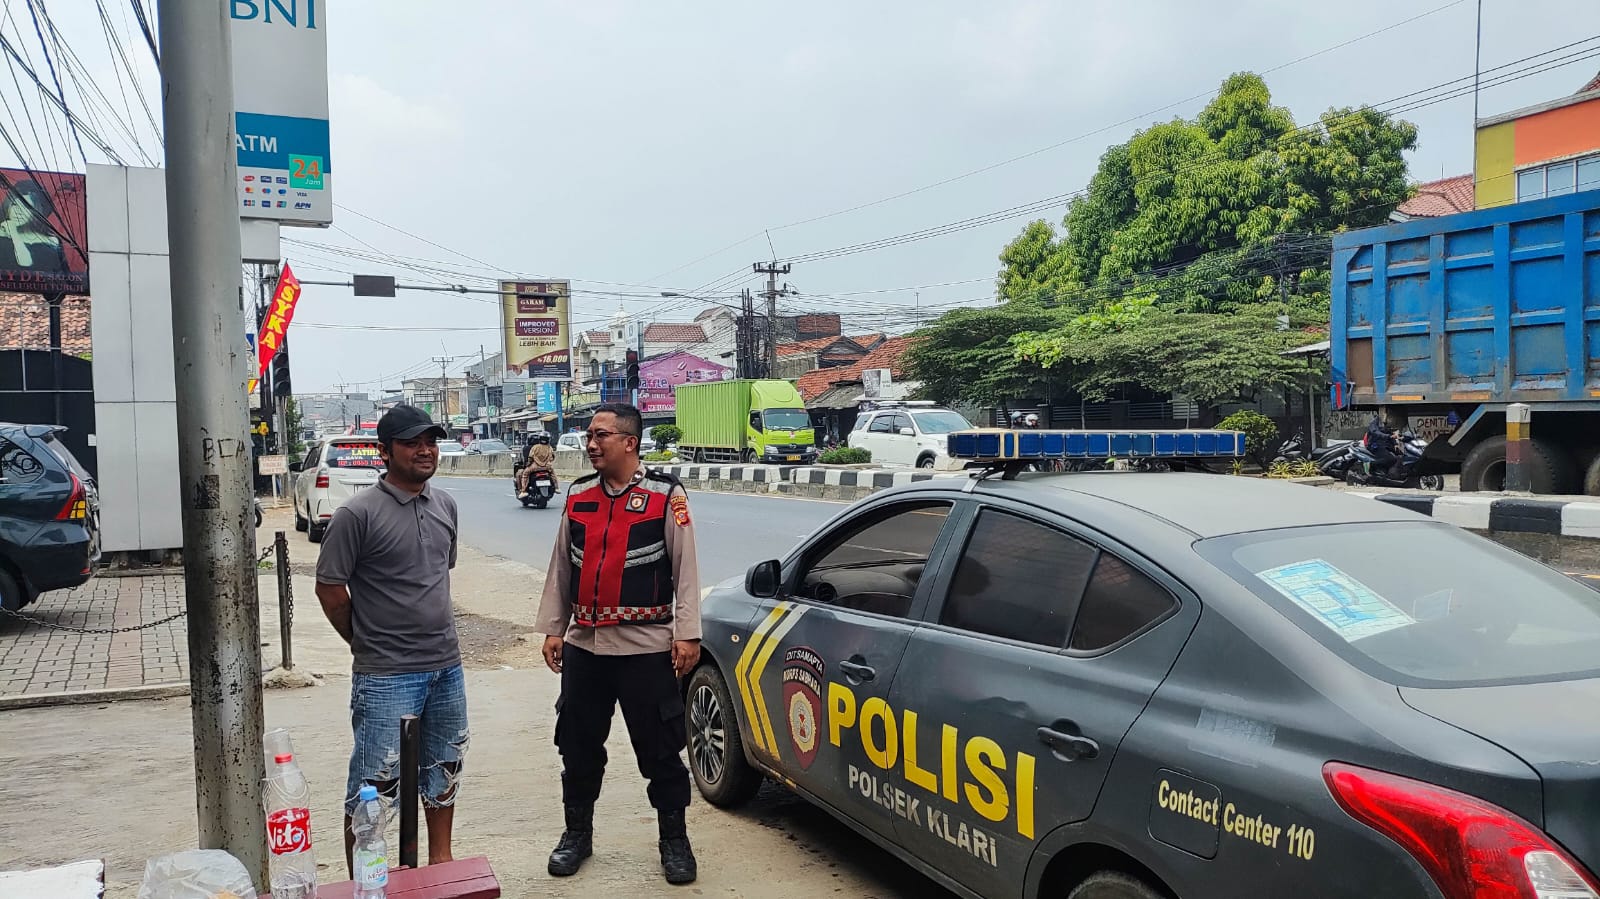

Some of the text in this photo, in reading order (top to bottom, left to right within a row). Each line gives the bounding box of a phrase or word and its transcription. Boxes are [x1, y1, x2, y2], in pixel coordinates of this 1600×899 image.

[230, 0, 317, 29] BNI
[236, 134, 278, 153] ATM
[293, 158, 320, 179] 24
[828, 681, 1036, 841] POLISI
[848, 764, 998, 868] POLSEK KLARI
[1158, 779, 1315, 860] Contact Center 110
